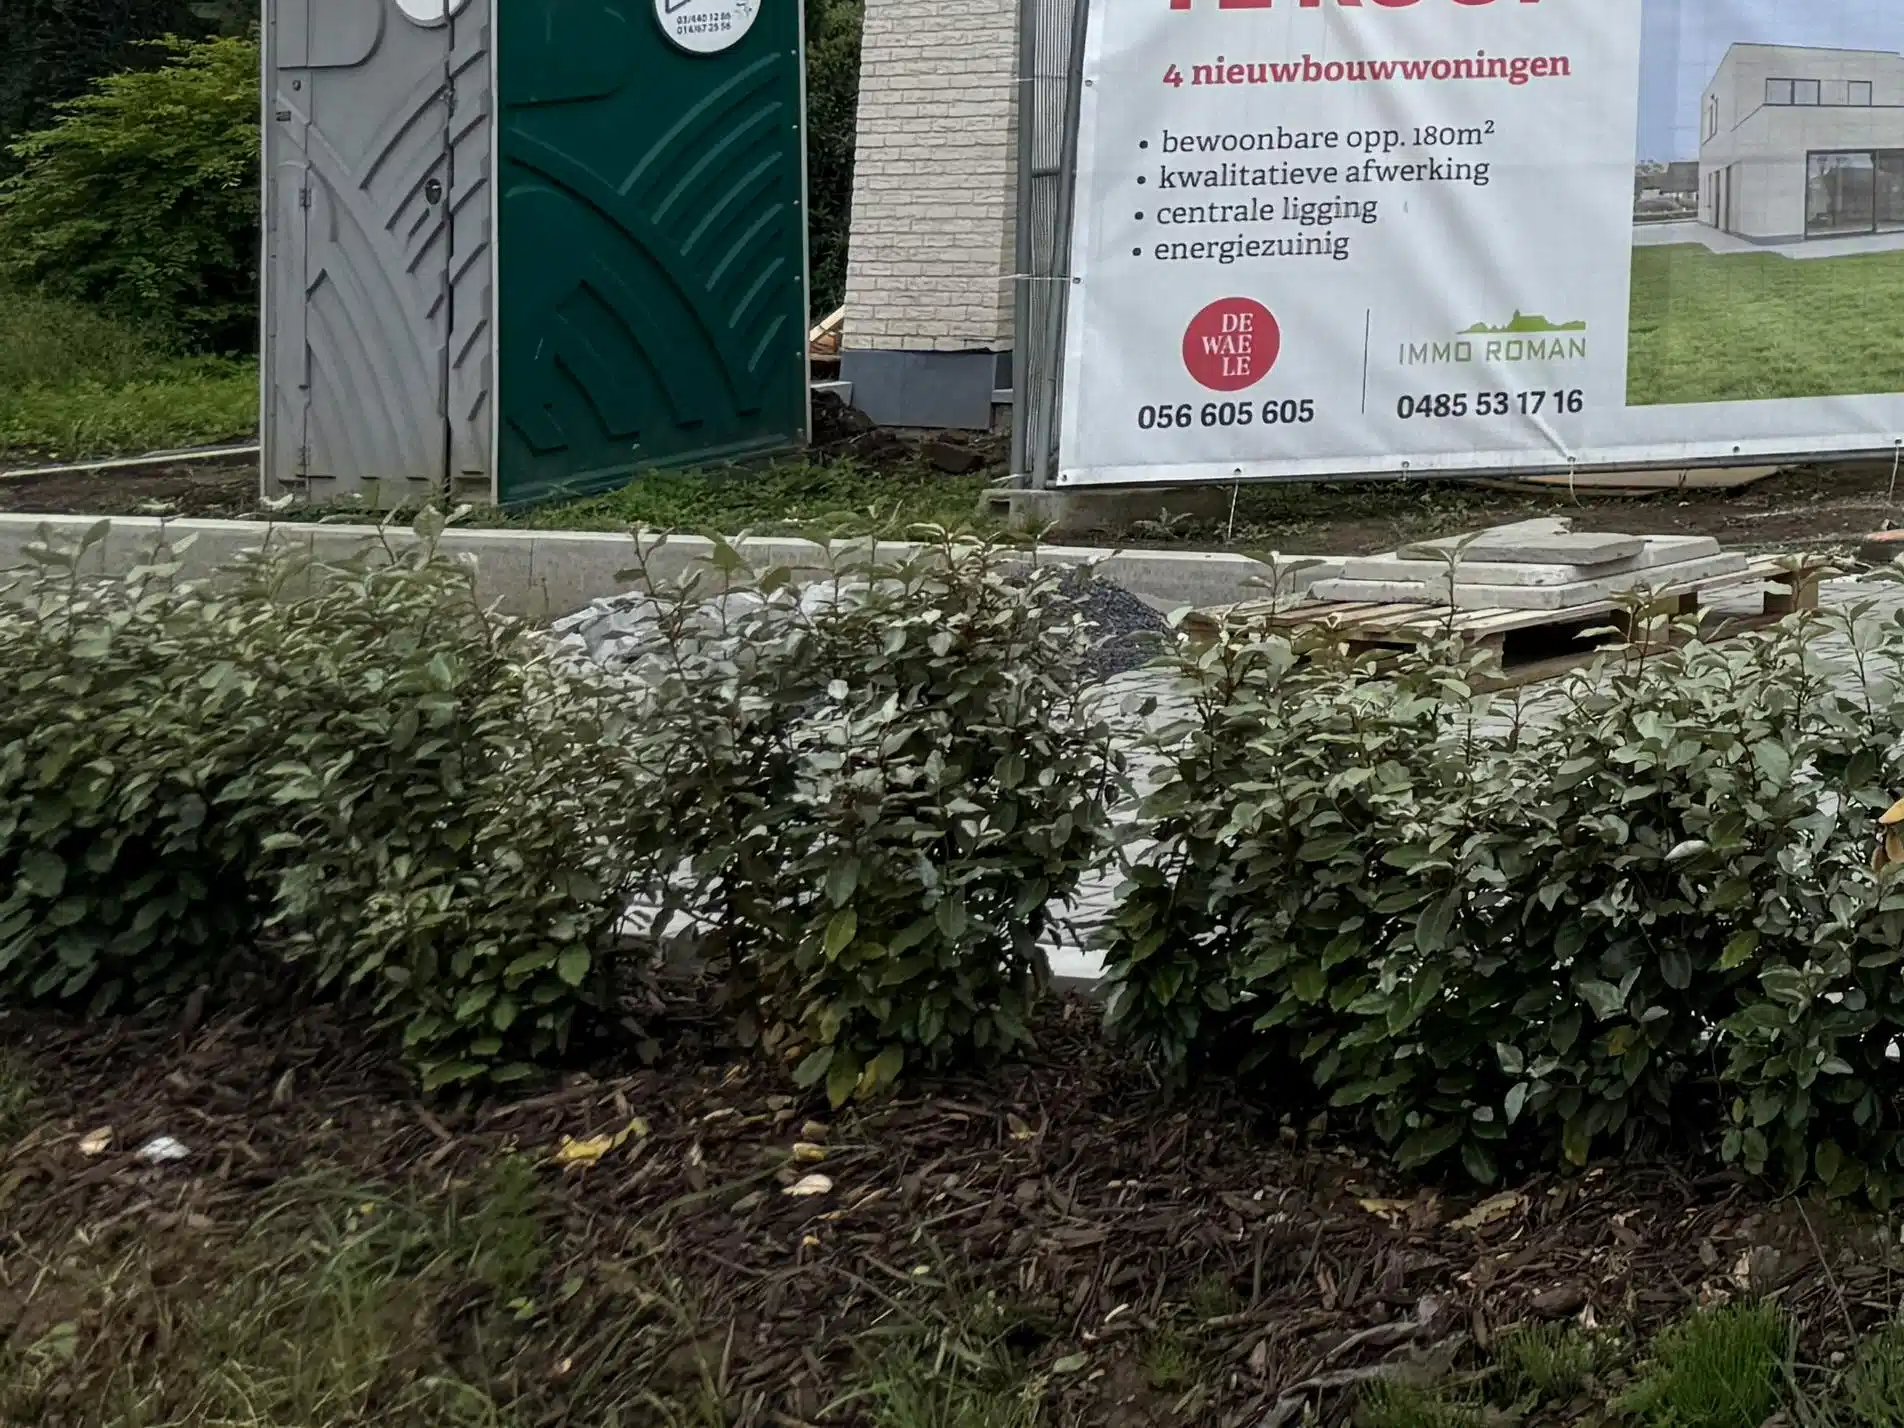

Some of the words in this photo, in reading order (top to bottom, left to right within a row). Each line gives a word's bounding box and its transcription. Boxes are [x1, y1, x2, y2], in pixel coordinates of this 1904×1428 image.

[1162, 62, 1184, 87] 4
[1191, 50, 1571, 85] nieuwbouwwoningen
[1163, 126, 1339, 154] bewoonbare
[1346, 128, 1406, 154] opp.
[1159, 161, 1338, 189] kwalitatieve
[1345, 157, 1491, 186] afwerking
[1157, 197, 1274, 225] centrale
[1282, 195, 1378, 225] ligging
[1154, 231, 1350, 264] energiezuinig
[1222, 313, 1254, 333] DE
[1201, 334, 1252, 355] WAE
[1399, 341, 1472, 366] IMMO
[1485, 337, 1586, 361] ROMAN
[1222, 356, 1250, 377] LE
[1138, 404, 1193, 430] 056
[1200, 401, 1254, 428] 605
[1262, 398, 1315, 425] 605
[1397, 393, 1468, 420] 0485
[1475, 391, 1509, 417] 53
[1517, 389, 1545, 415] 17
[1553, 389, 1584, 414] 16
